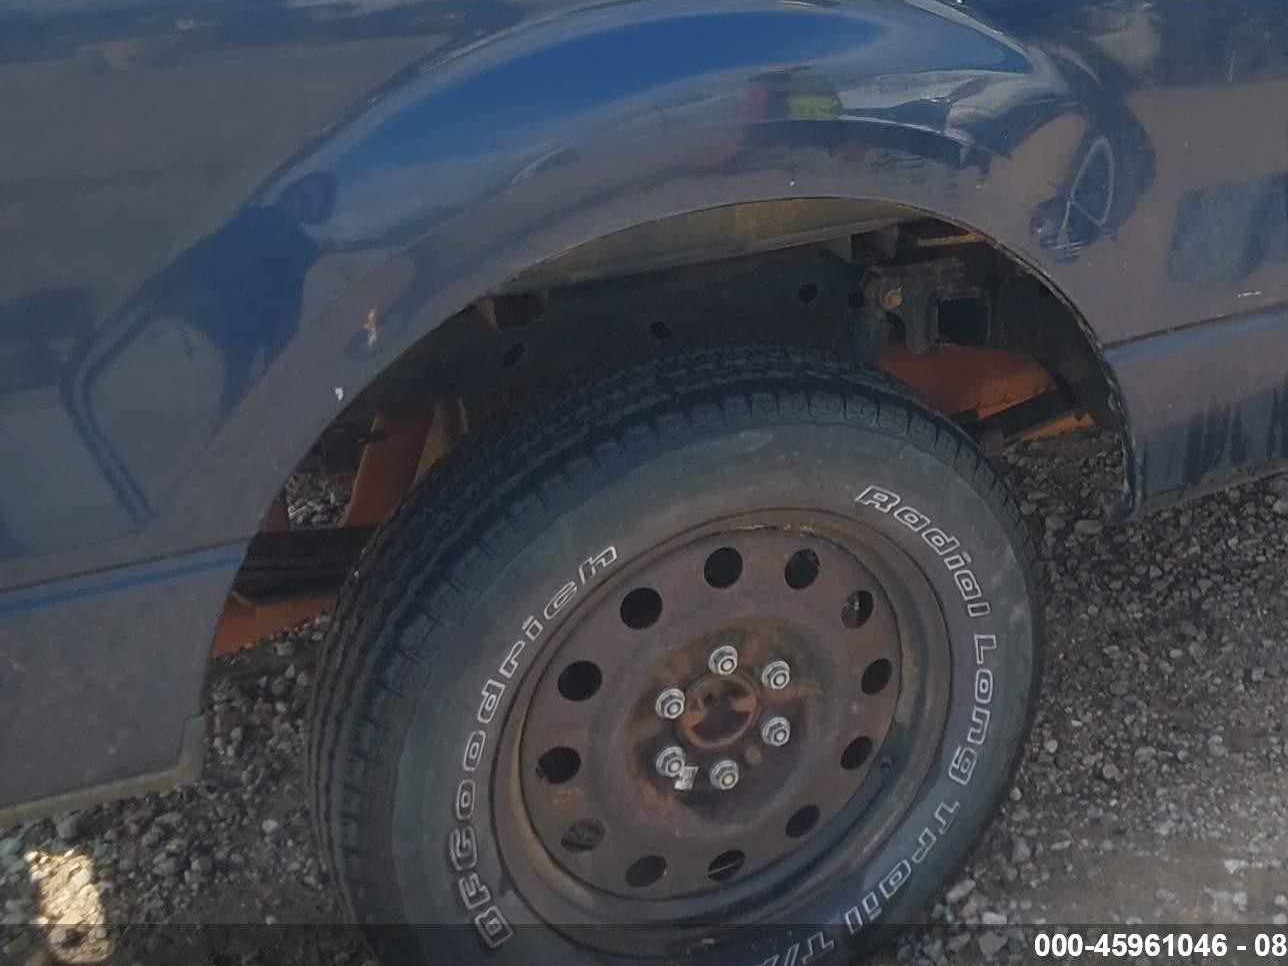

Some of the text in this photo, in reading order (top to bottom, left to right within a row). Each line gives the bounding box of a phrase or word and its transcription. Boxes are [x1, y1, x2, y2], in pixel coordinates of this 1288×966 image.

[854, 485, 992, 618] Radial
[451, 545, 618, 948] BFGoodrich
[948, 633, 997, 786] Long
[843, 800, 961, 935] Trail
